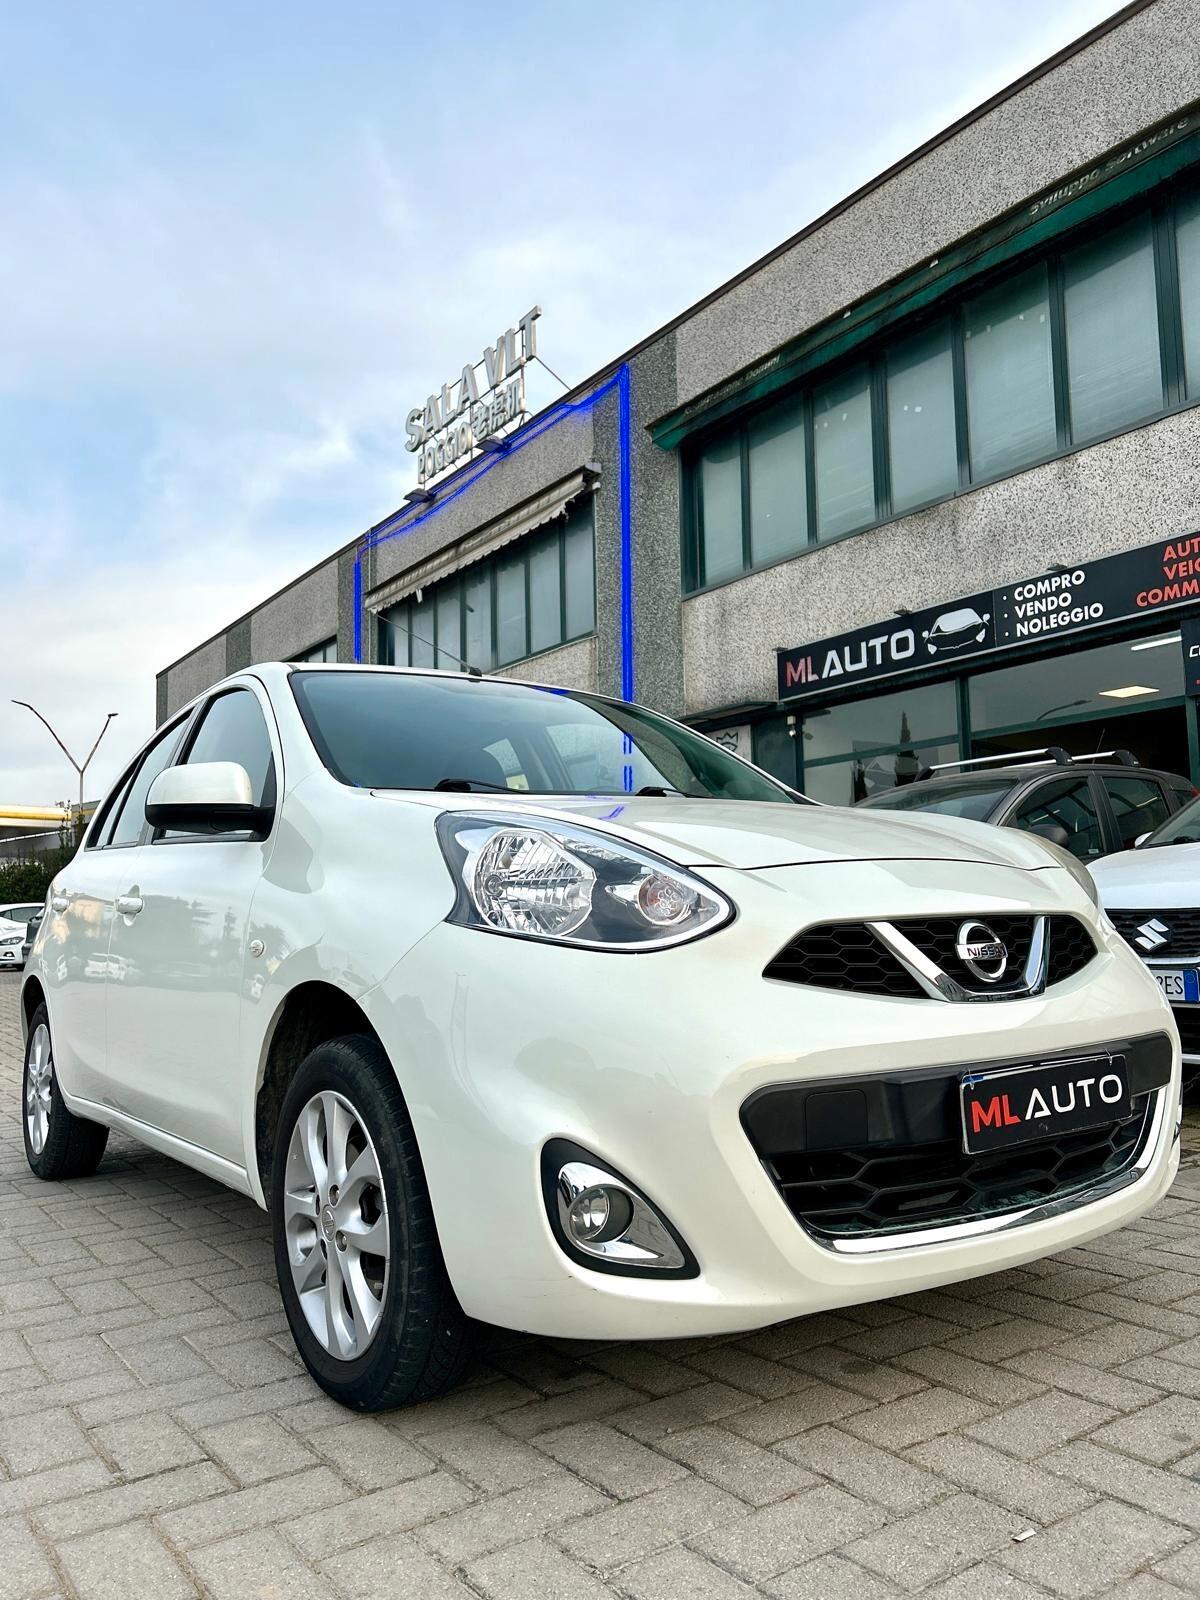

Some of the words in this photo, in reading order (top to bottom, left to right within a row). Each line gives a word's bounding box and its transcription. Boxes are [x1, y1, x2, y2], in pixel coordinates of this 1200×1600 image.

[405, 363, 479, 453] SALA
[483, 304, 542, 389] VLT
[417, 421, 473, 485] POGGIO
[1014, 570, 1085, 601] COMPRO
[1014, 592, 1072, 618] VENDO
[1016, 602, 1103, 637] NOLEGGIO
[785, 656, 819, 687] ML
[821, 628, 915, 679] AUTO
[971, 1094, 1021, 1133] ML
[1025, 1074, 1123, 1121] AUTO
